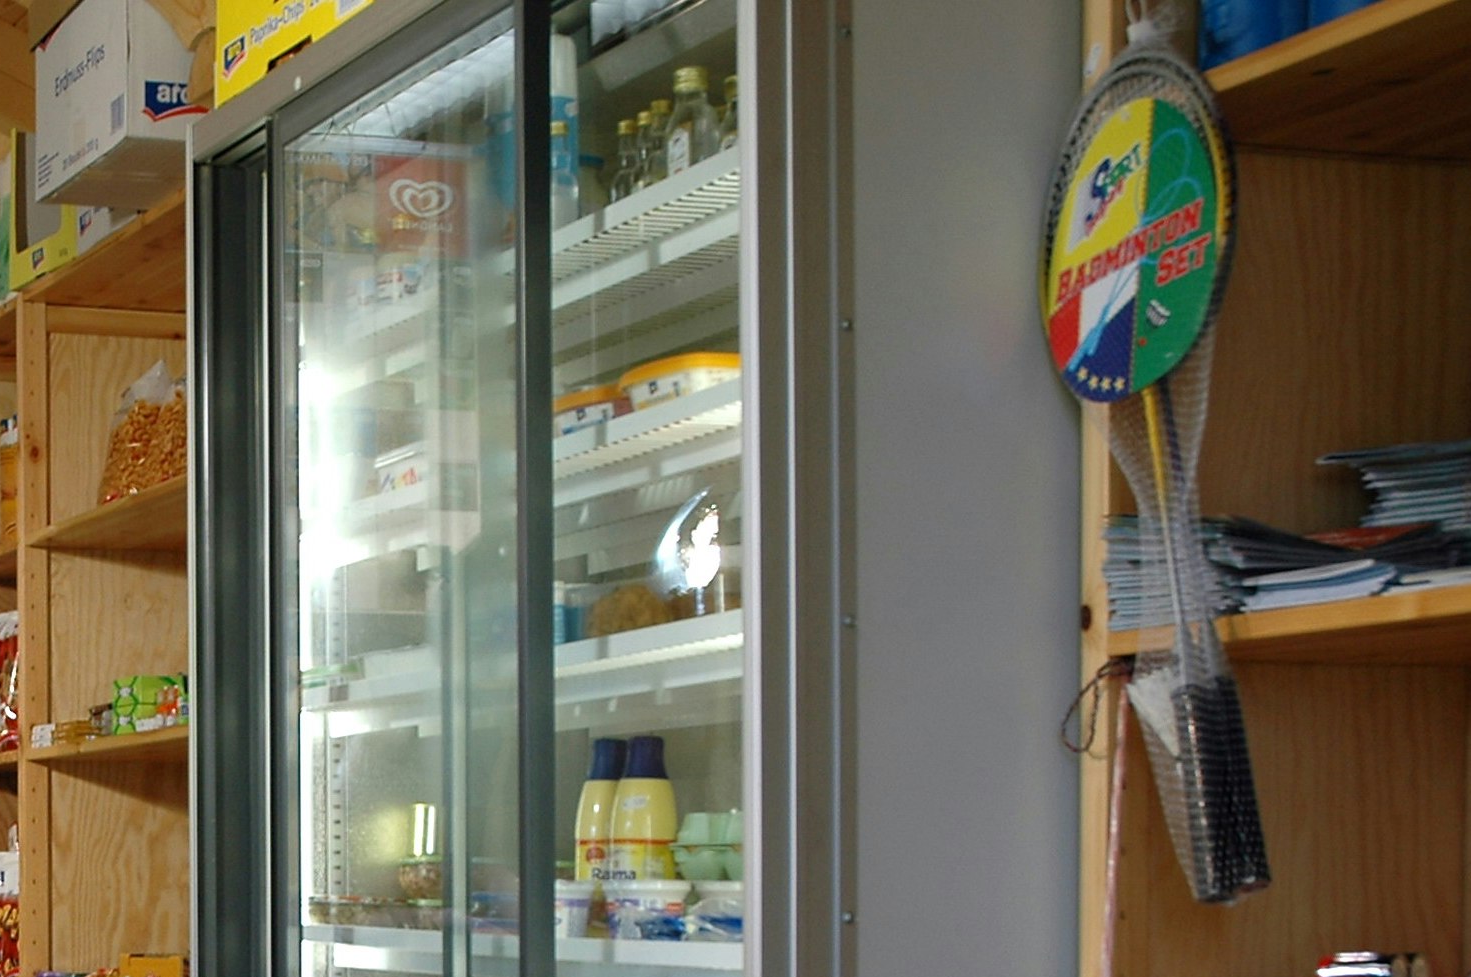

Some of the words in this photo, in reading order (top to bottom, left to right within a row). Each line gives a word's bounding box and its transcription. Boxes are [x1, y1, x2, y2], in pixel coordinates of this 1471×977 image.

[54, 44, 106, 97] Erdnuss-Flips
[1056, 197, 1205, 307] BADMINTON
[1156, 230, 1212, 287] SET
